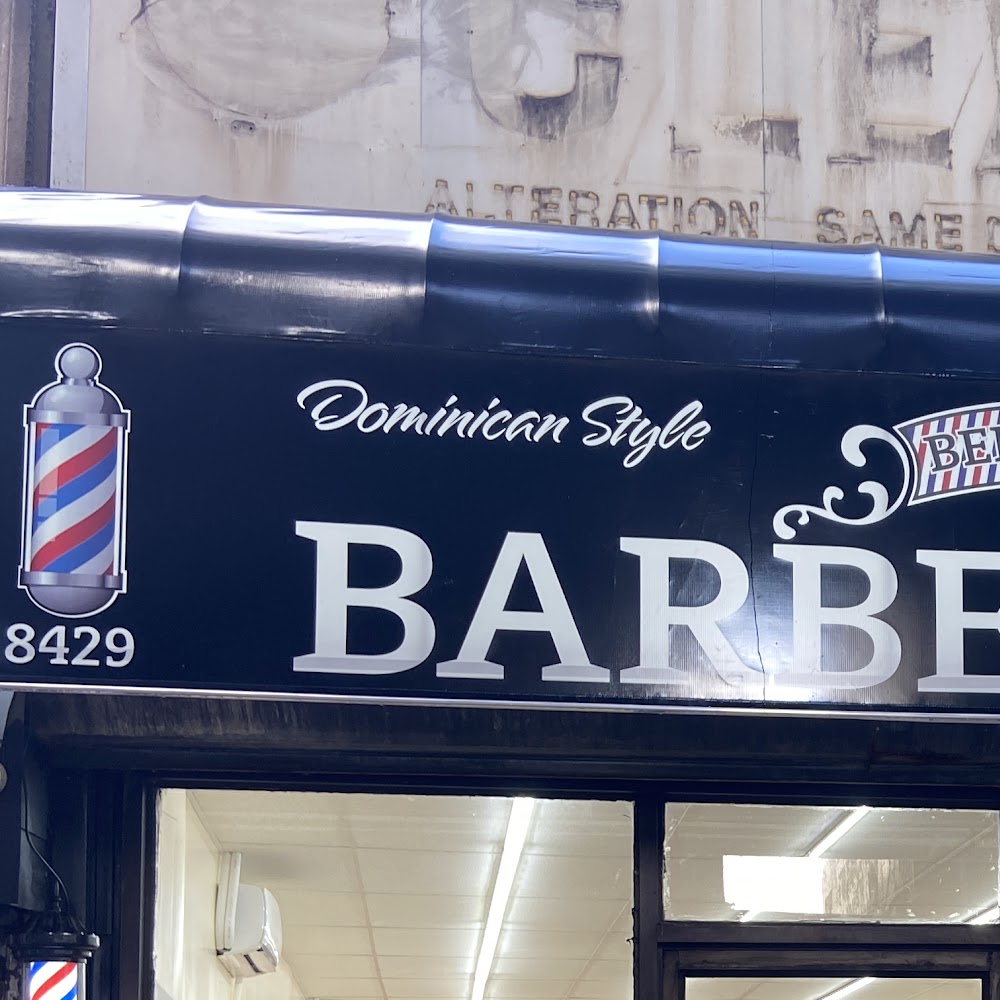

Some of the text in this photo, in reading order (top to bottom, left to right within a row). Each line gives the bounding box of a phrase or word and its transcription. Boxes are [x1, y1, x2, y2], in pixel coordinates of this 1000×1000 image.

[424, 179, 760, 239] ALTERATION
[815, 206, 964, 252] SAME
[296, 379, 713, 469] Dominican Style
[3, 621, 136, 669] 8429
